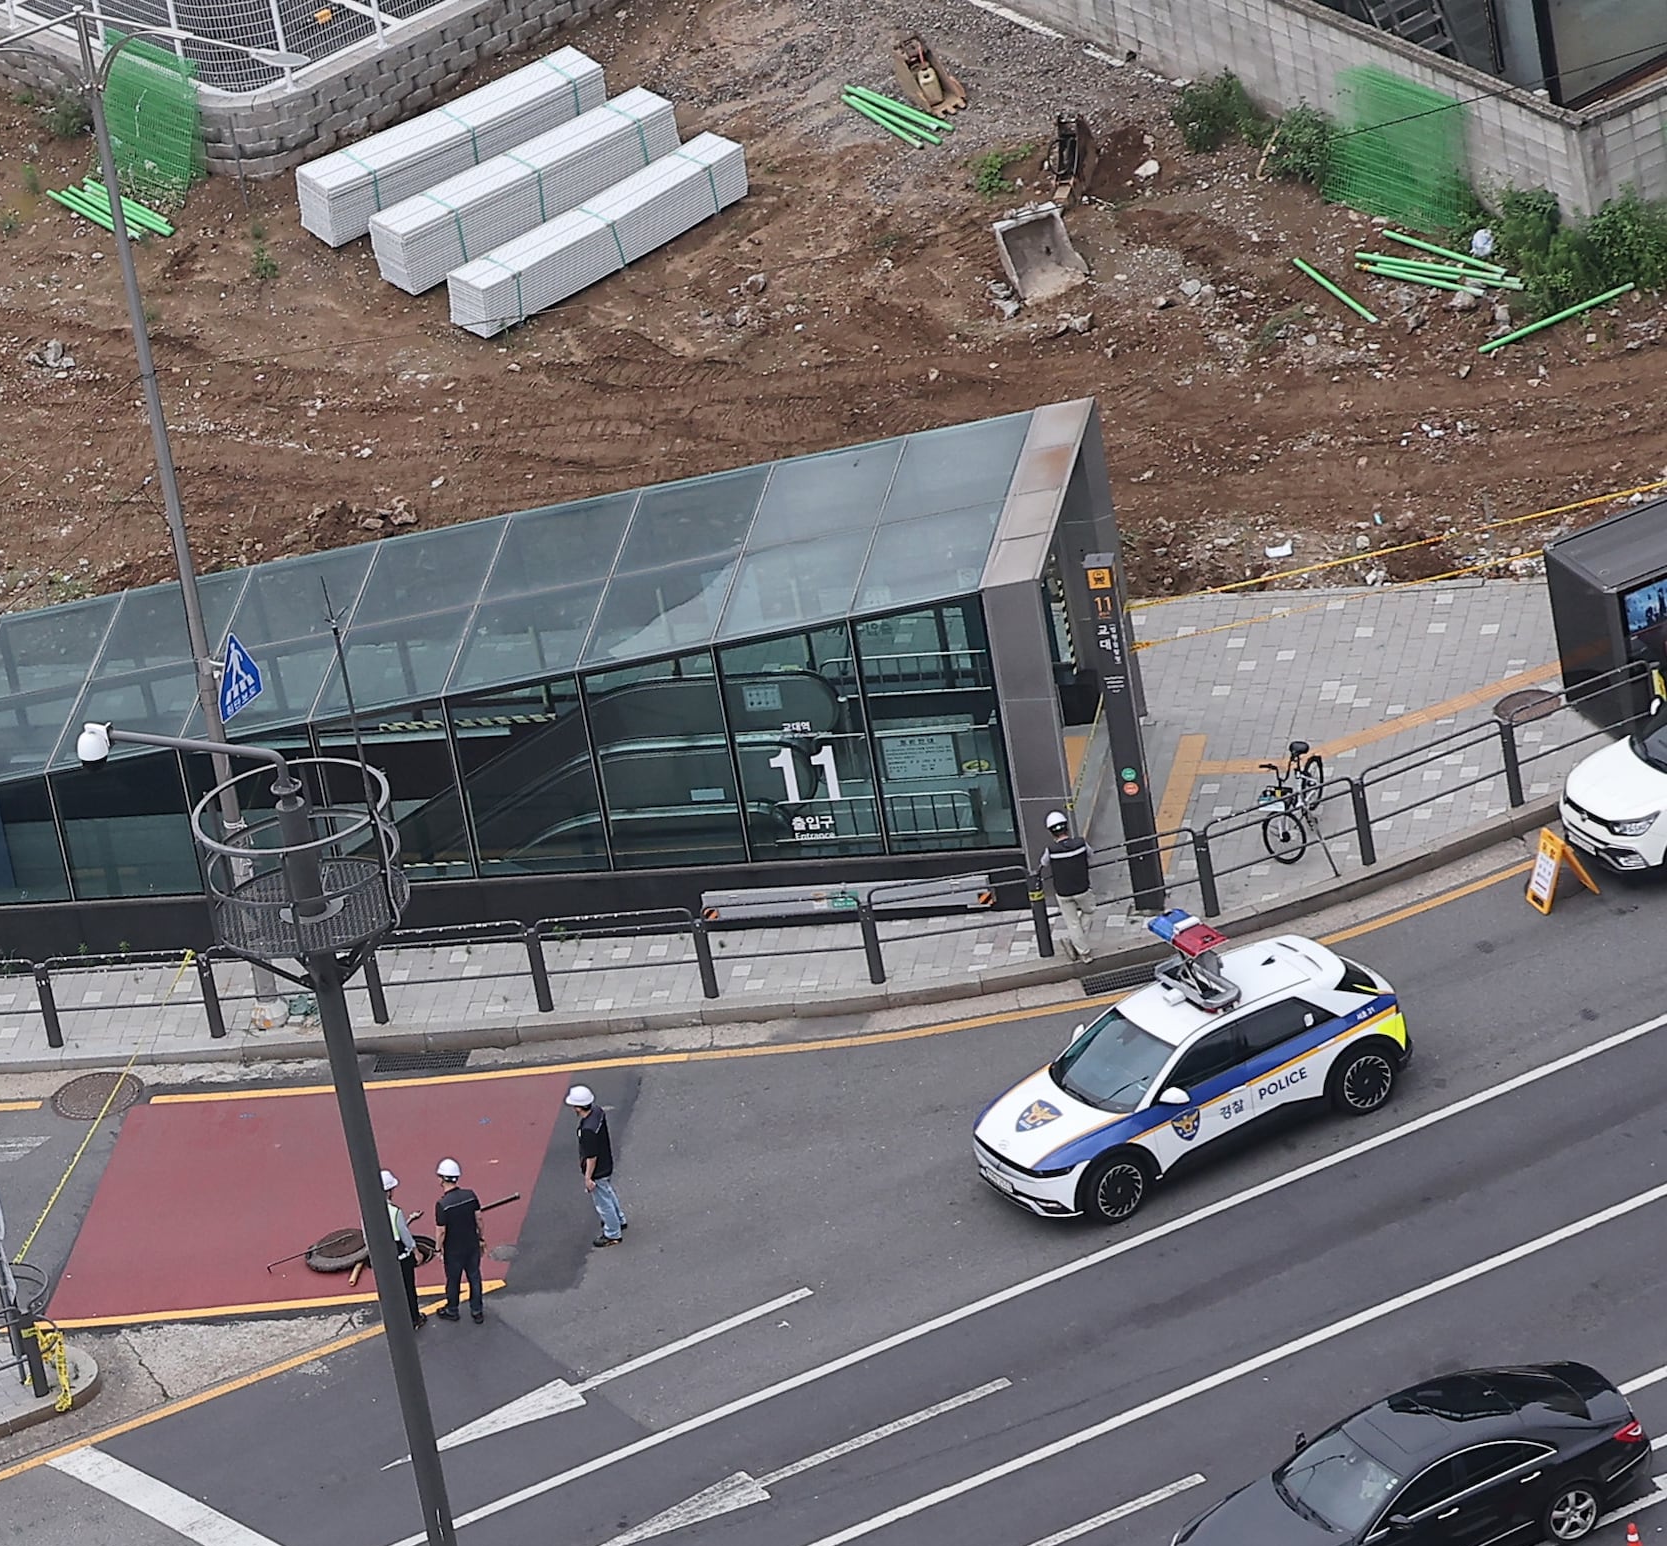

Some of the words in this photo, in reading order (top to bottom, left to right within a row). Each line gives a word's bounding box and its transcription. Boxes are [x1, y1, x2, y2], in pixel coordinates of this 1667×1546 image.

[1093, 596, 1113, 613] 11
[781, 720, 811, 732] 교대역
[768, 745, 842, 803] 11
[791, 815, 835, 831] 출입구
[794, 831, 835, 840] Entrance
[1258, 1066, 1308, 1101] POLICE
[1219, 1097, 1245, 1121] 경찰
